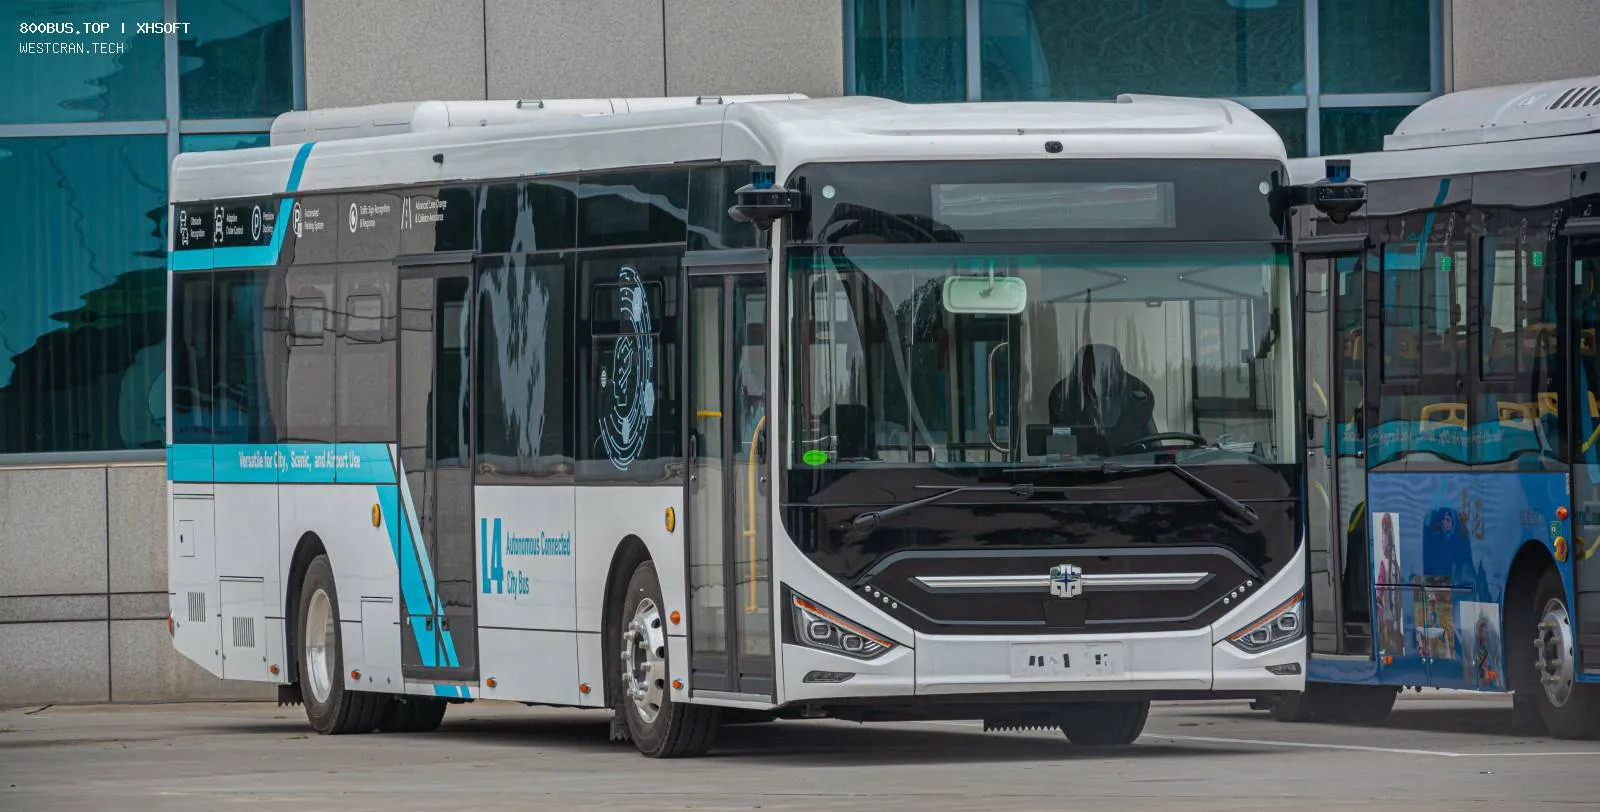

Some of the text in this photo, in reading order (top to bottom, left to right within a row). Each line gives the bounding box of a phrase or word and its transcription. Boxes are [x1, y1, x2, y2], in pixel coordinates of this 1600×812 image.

[238, 450, 361, 473] Versatile for City, Scenic, and Airport Use
[481, 517, 504, 594] L4
[506, 530, 571, 555] Autonomous Connected
[506, 569, 530, 600] City Bus
